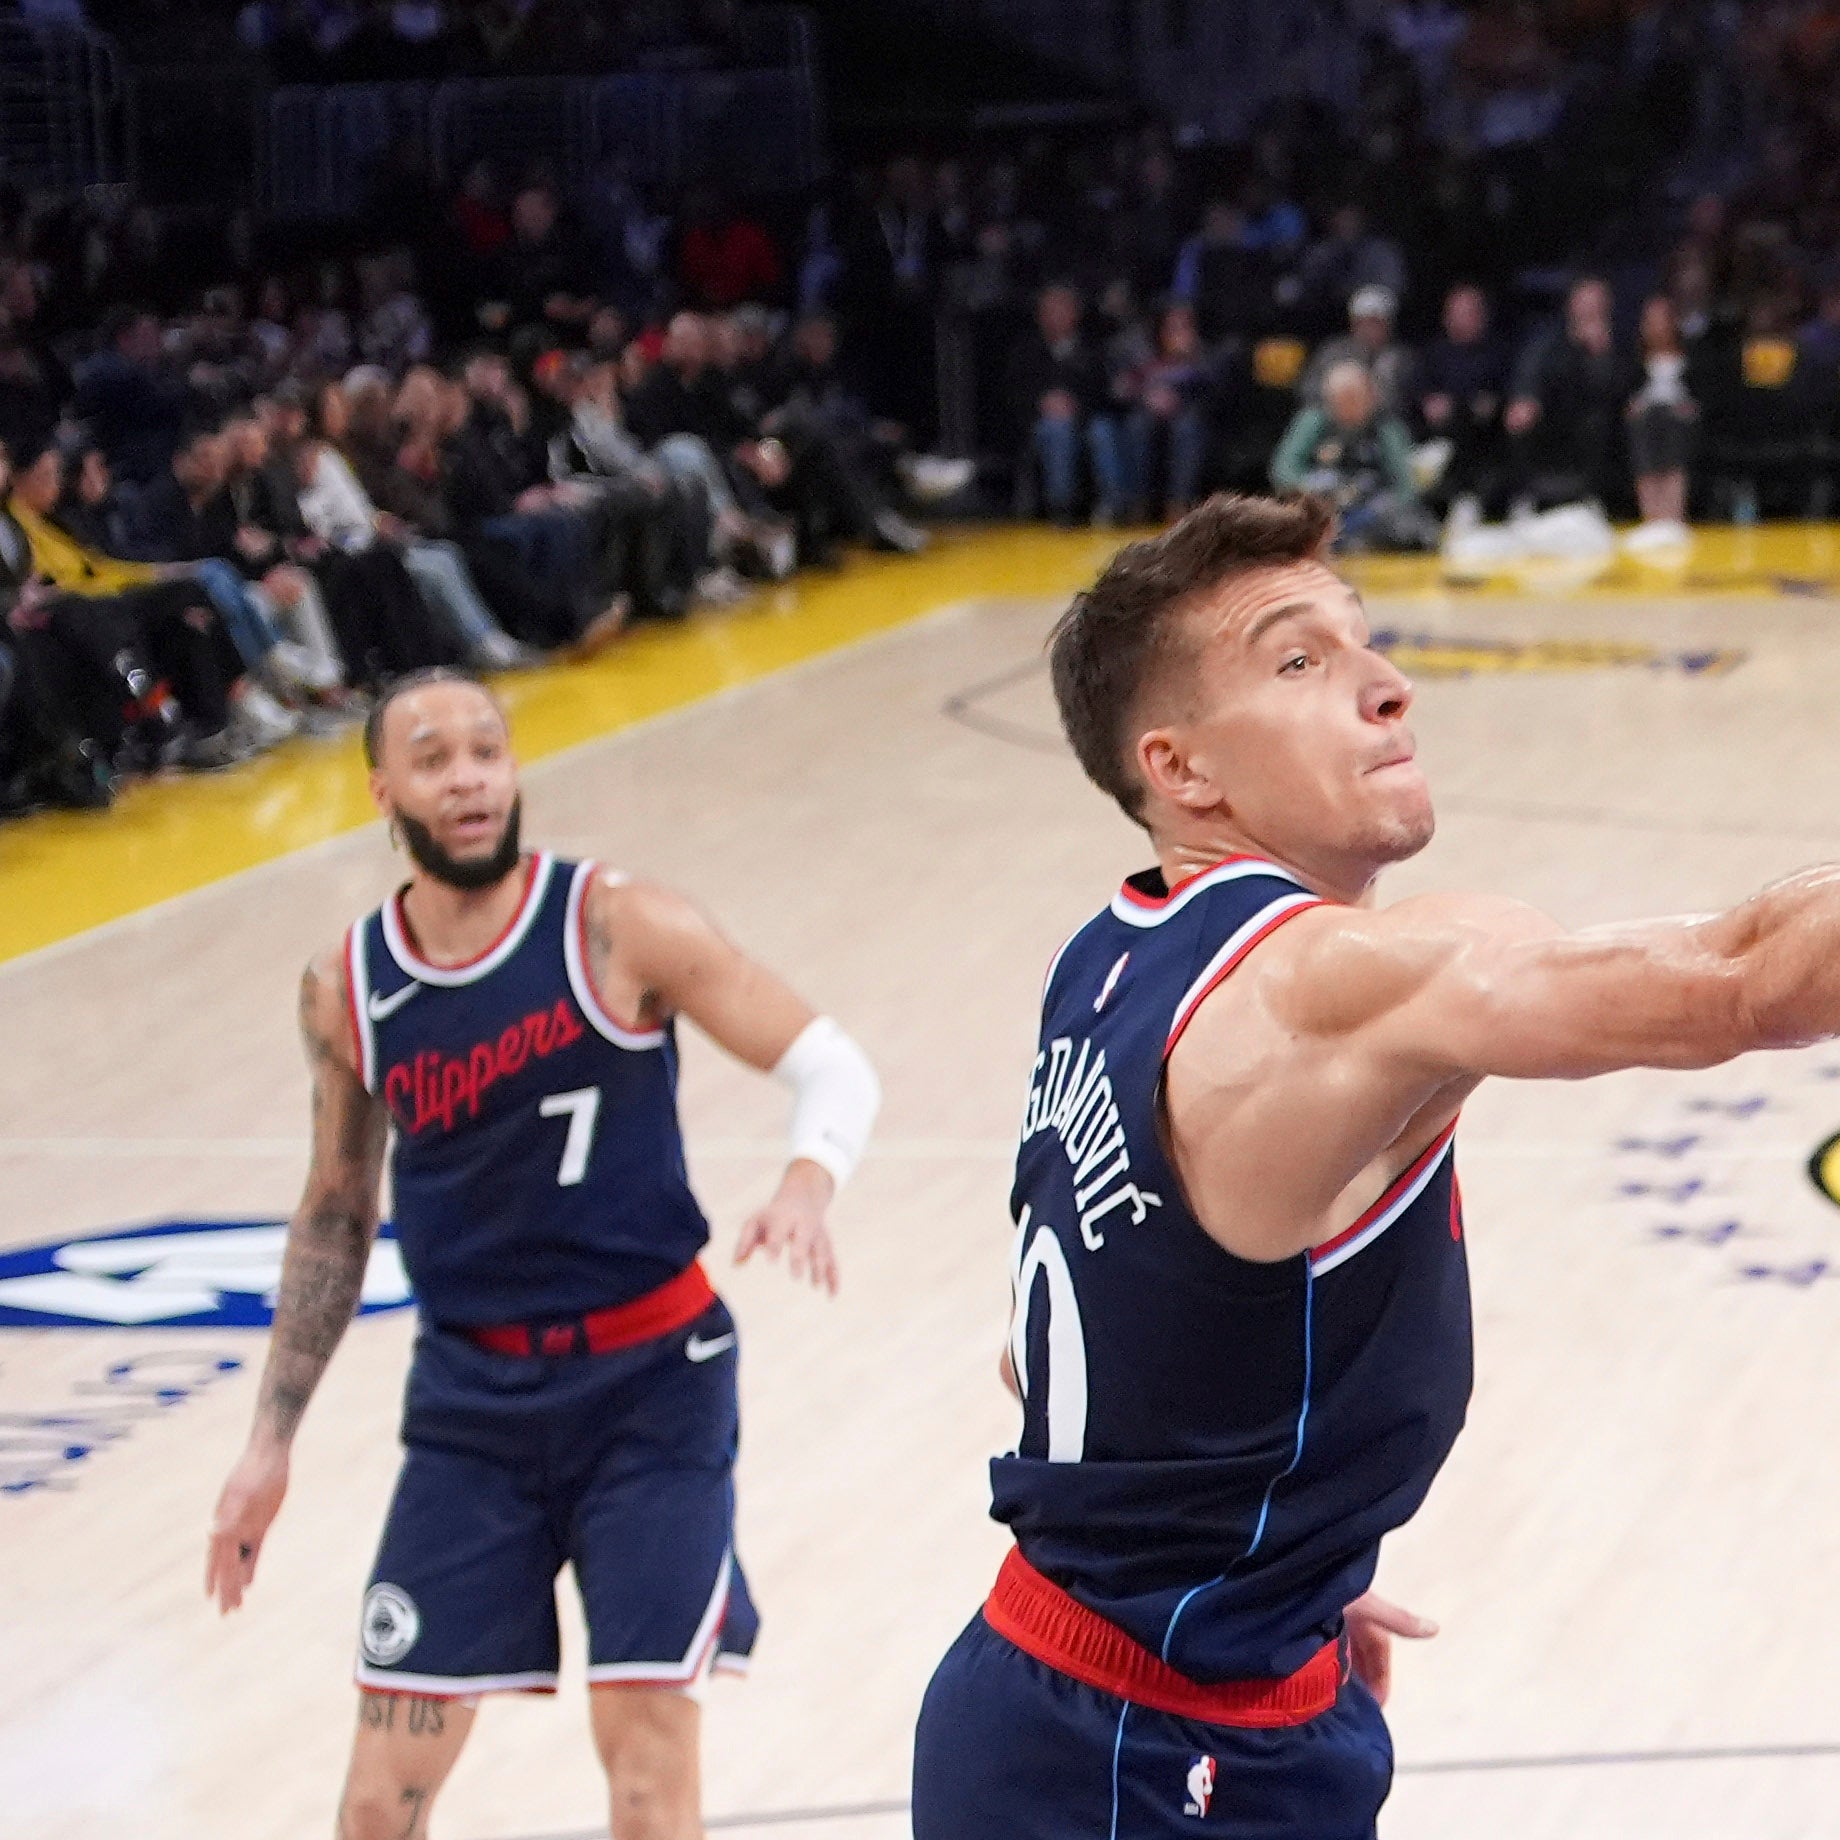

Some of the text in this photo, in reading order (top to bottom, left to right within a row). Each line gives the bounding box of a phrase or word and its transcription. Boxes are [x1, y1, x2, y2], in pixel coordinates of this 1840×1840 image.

[385, 997, 583, 1135] Clippers
[538, 1085, 600, 1188] 7
[1022, 1037, 1163, 1252] GDANOVIĆ
